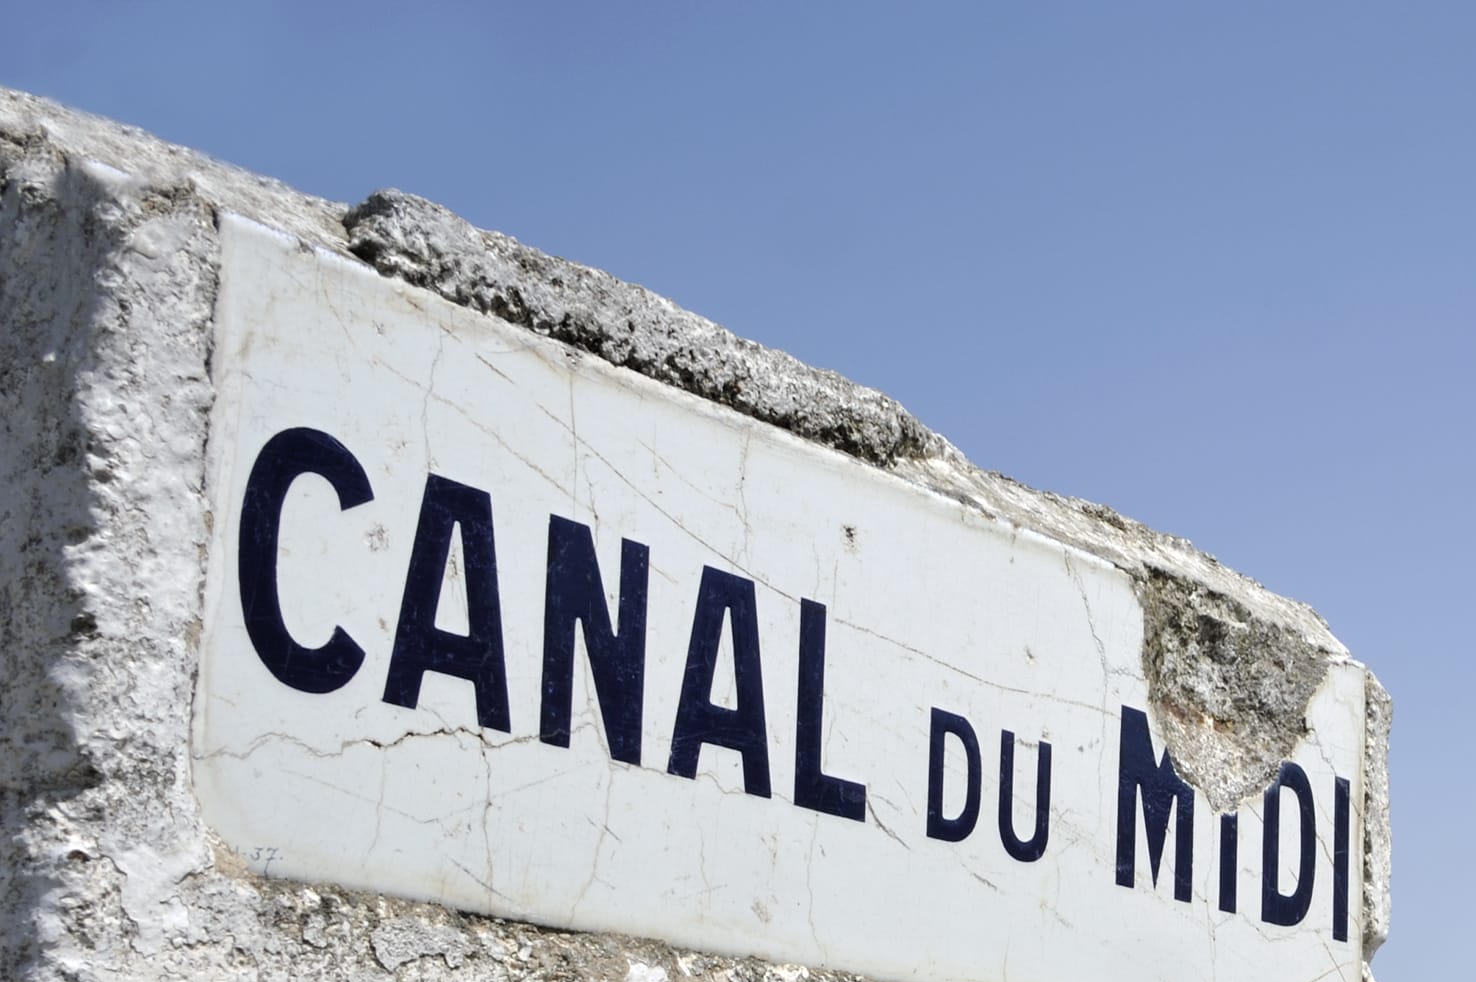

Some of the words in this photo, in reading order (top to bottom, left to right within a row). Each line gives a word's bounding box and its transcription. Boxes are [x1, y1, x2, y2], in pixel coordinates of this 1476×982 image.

[238, 426, 867, 824] CANAL
[926, 707, 1052, 863] DU
[1115, 704, 1350, 943] MIDI
